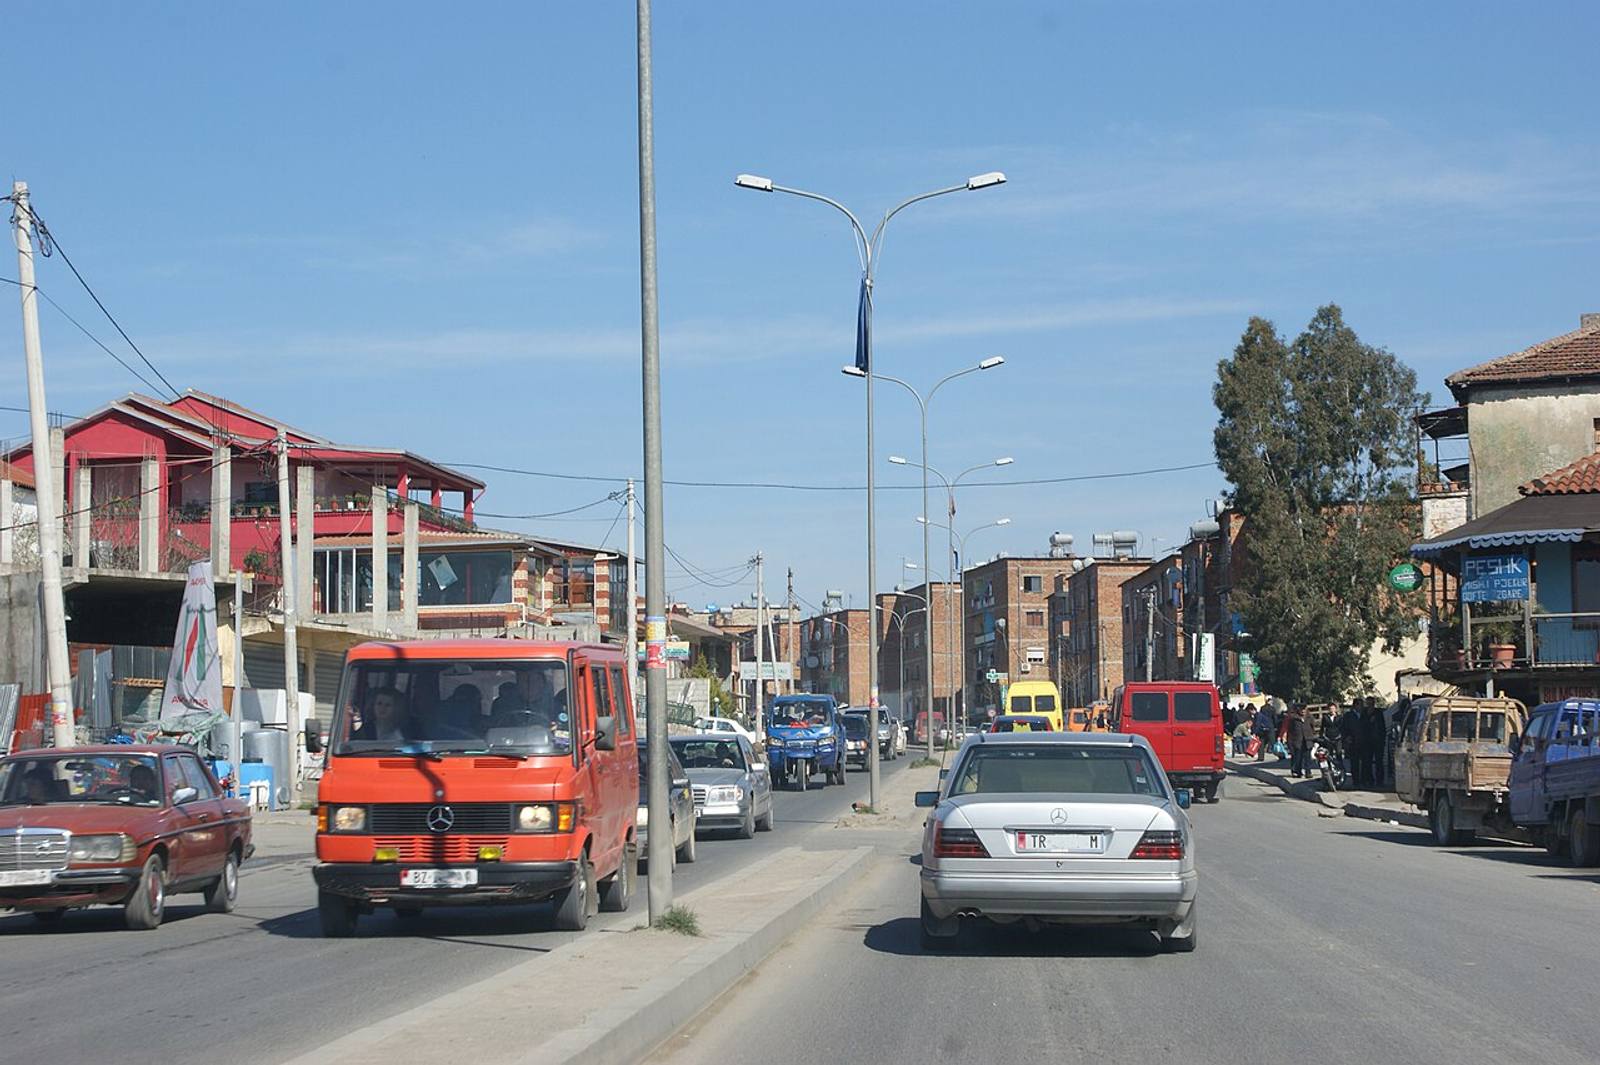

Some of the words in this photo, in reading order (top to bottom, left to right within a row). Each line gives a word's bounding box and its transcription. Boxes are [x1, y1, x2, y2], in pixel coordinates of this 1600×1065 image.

[1465, 557, 1522, 576] PESHK
[1031, 834, 1047, 849] TR
[1089, 835, 1098, 849] M
